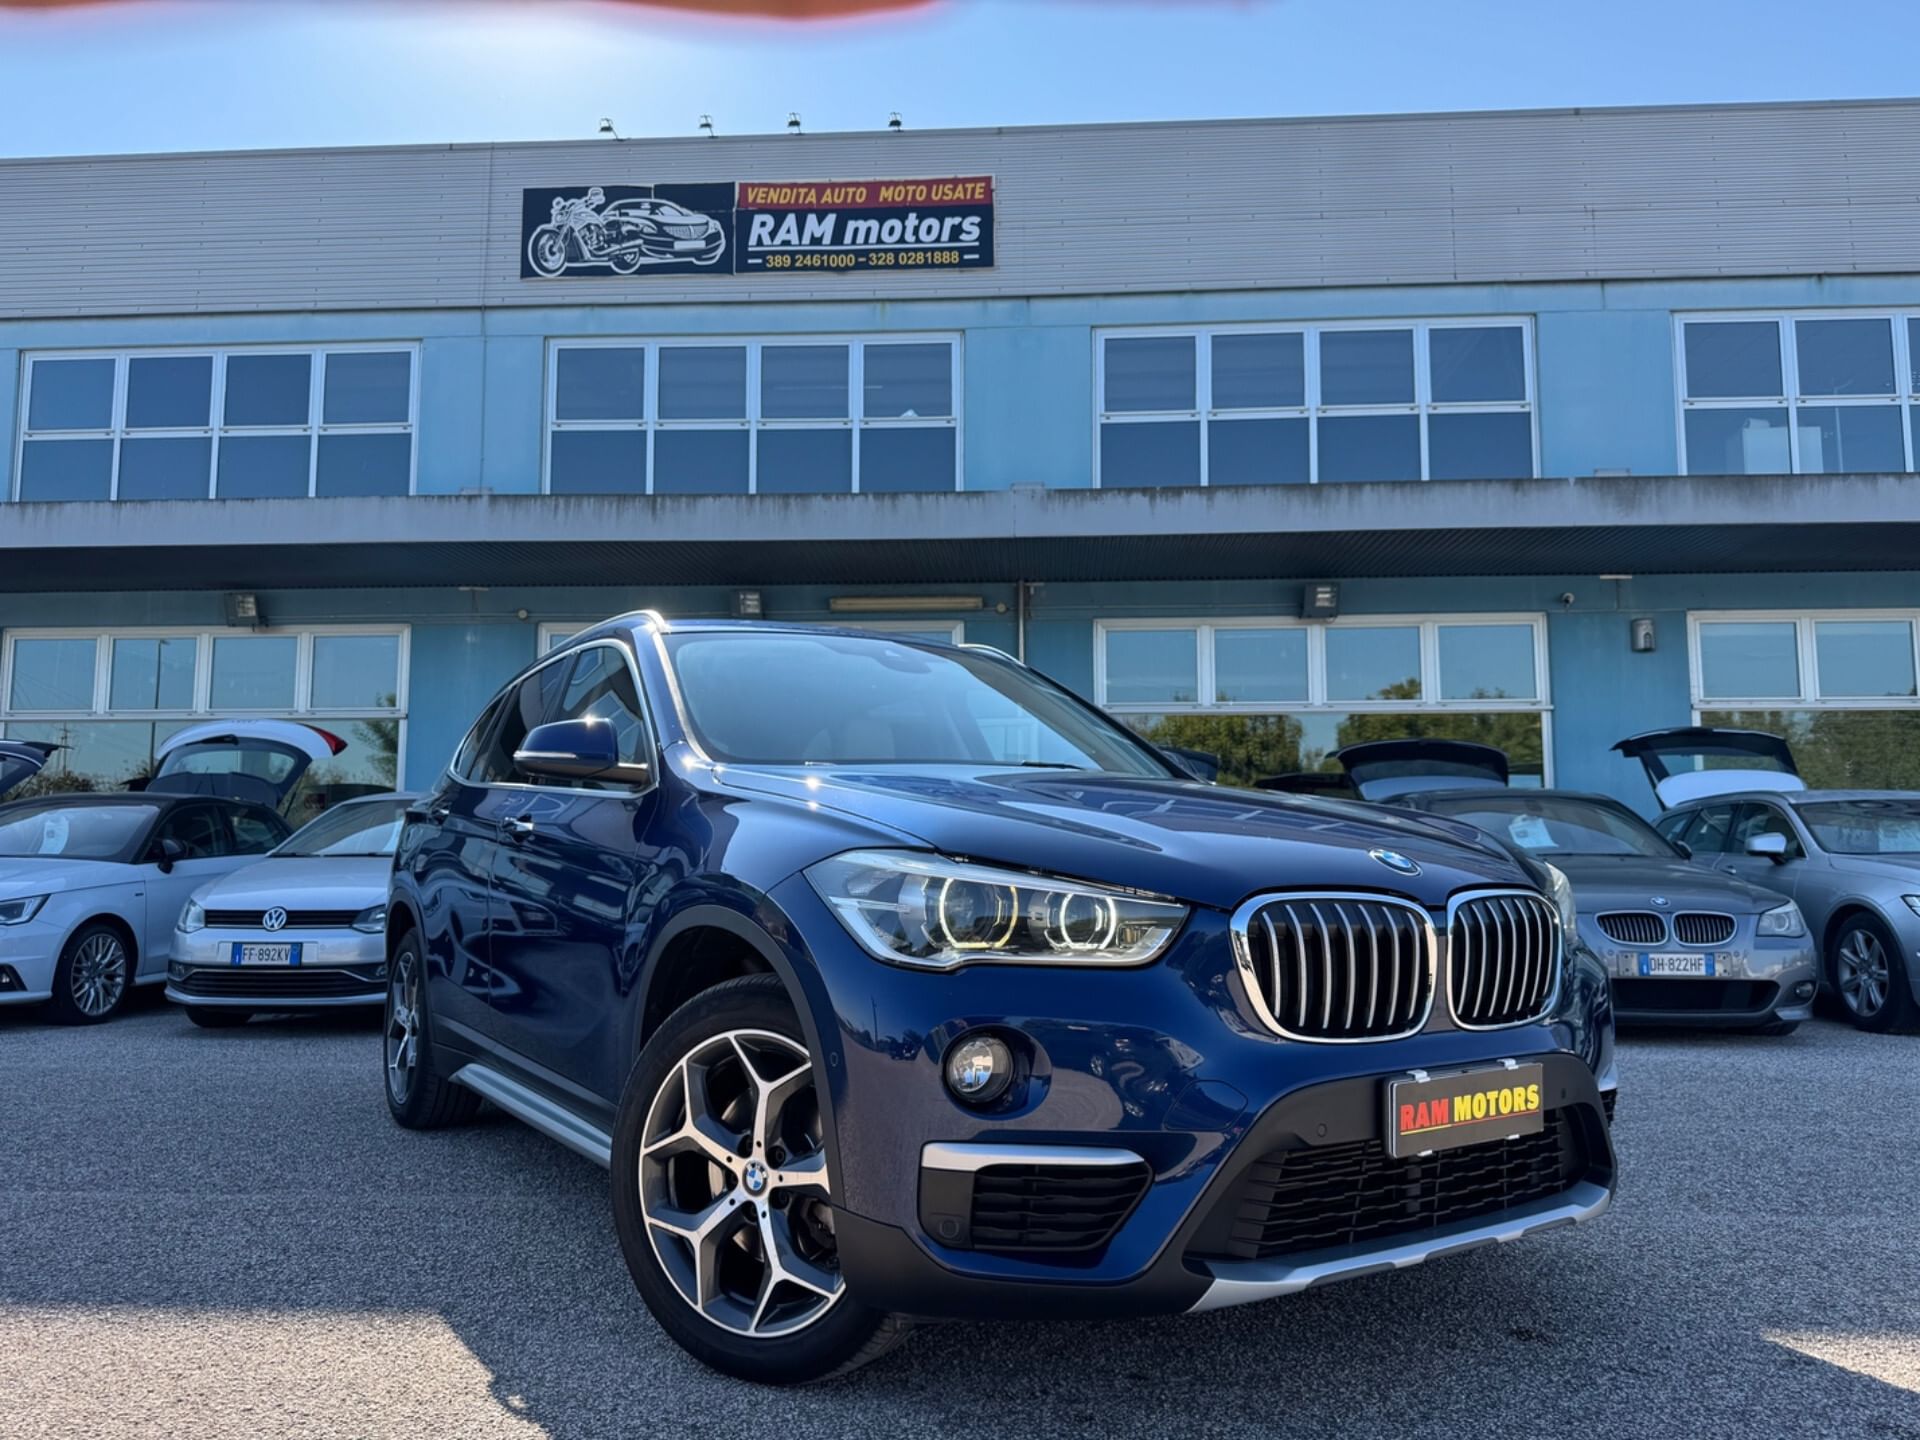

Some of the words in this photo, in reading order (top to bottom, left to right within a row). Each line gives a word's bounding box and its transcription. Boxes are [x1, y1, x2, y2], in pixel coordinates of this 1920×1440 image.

[747, 187, 817, 204] VENDITA
[821, 187, 867, 203] AUTO
[879, 184, 927, 202] MOTO
[931, 183, 986, 201] USATE
[748, 213, 837, 245] RAM
[843, 212, 982, 245] motors
[766, 255, 790, 267] 389
[795, 253, 855, 267] 2461000
[869, 253, 894, 265] 328
[899, 251, 960, 264] 0281888
[1400, 1098, 1449, 1131] RAM
[1454, 1084, 1540, 1123] MOTORS
